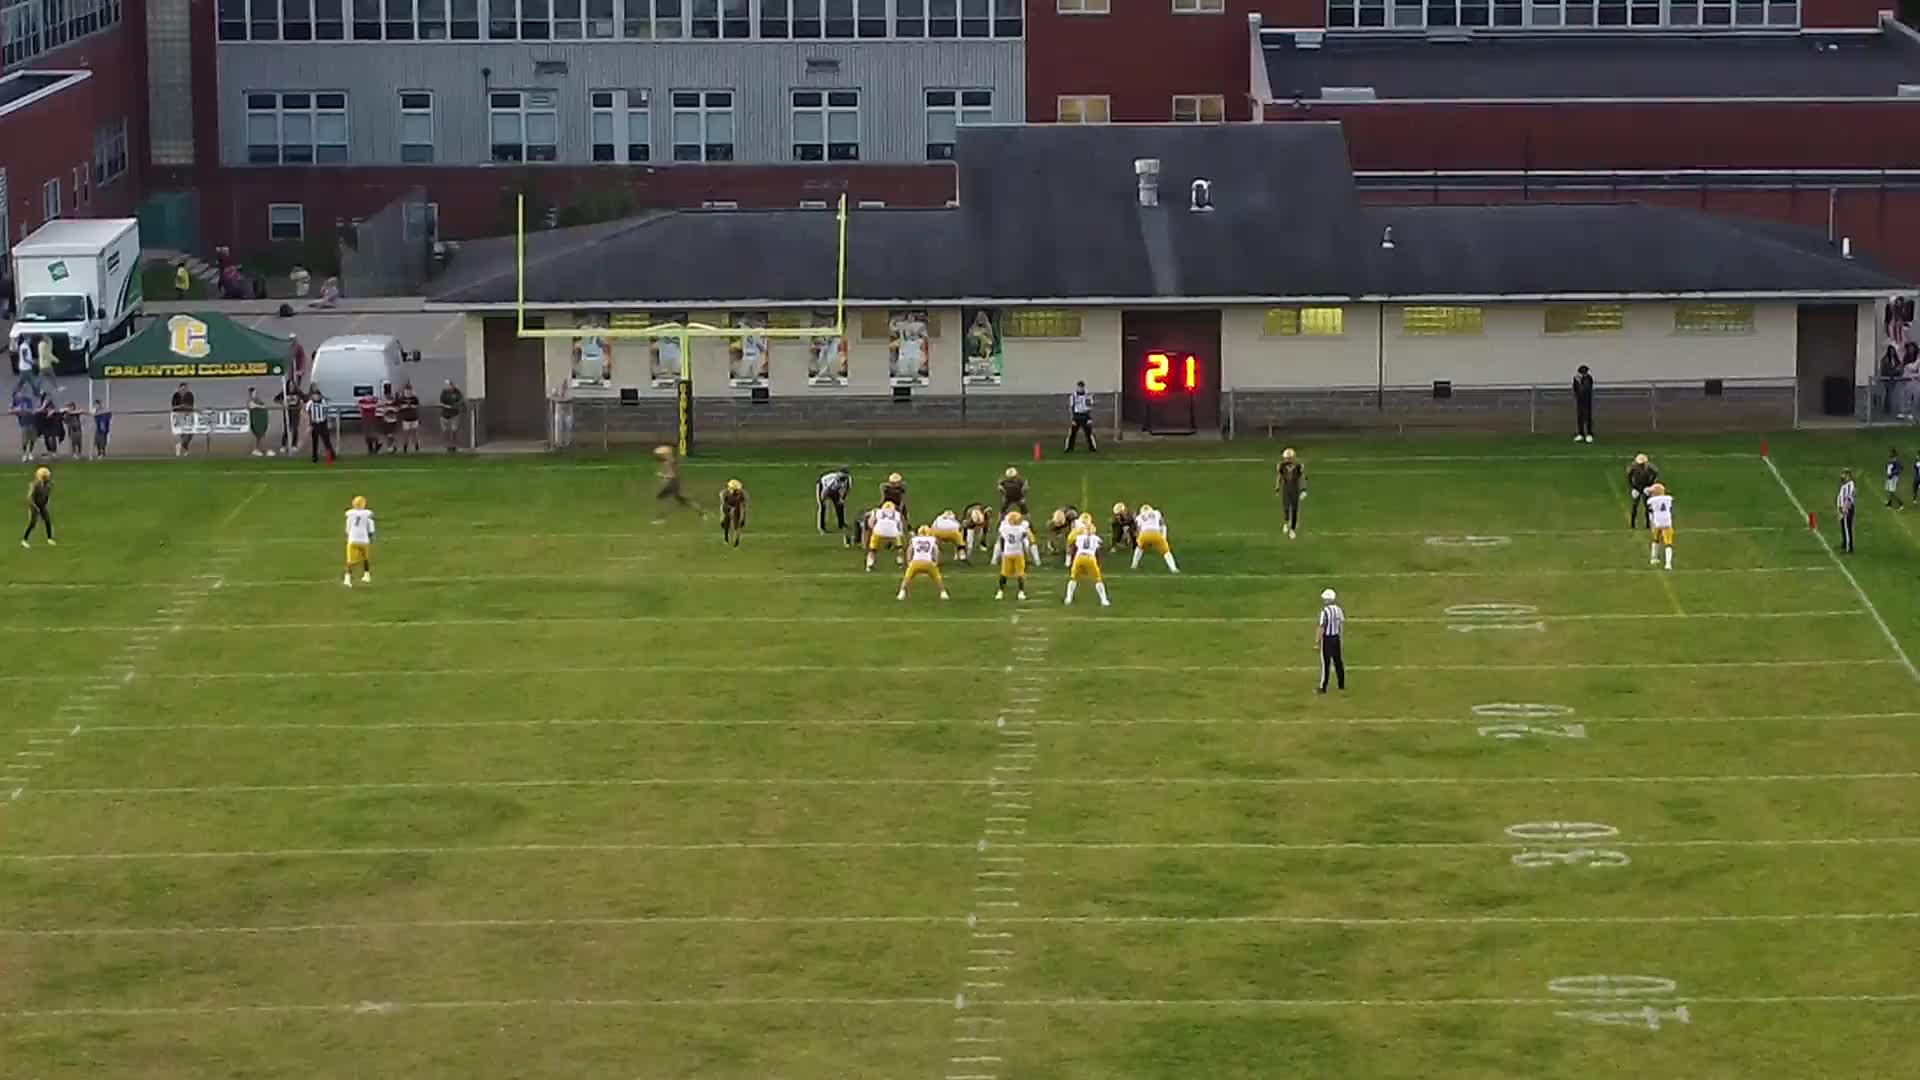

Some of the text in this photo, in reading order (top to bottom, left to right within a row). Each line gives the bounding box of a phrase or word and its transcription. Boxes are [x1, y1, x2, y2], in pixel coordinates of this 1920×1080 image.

[1146, 354, 1195, 391] 21
[1471, 702, 1587, 739] 20
[1504, 821, 1632, 867] 30
[1547, 975, 1692, 1030] 40
